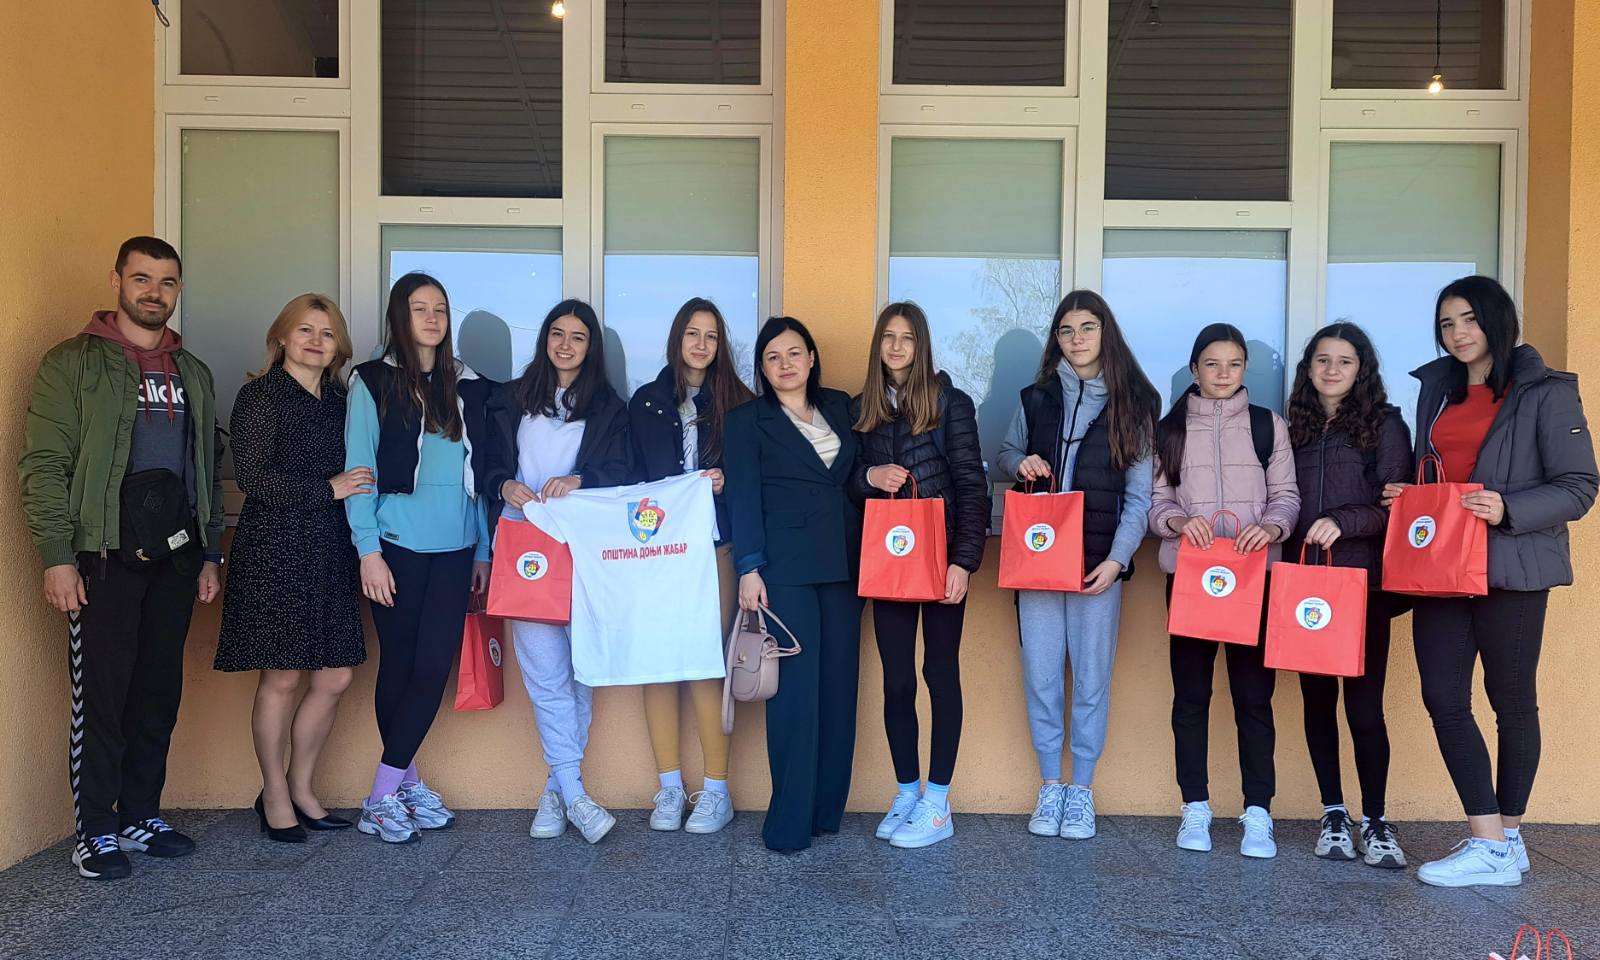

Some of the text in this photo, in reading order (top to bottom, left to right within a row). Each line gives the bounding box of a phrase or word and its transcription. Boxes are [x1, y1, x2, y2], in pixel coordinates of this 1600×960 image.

[601, 542, 688, 560] ОПШТИНА ДОЊИ ЖАБАР
